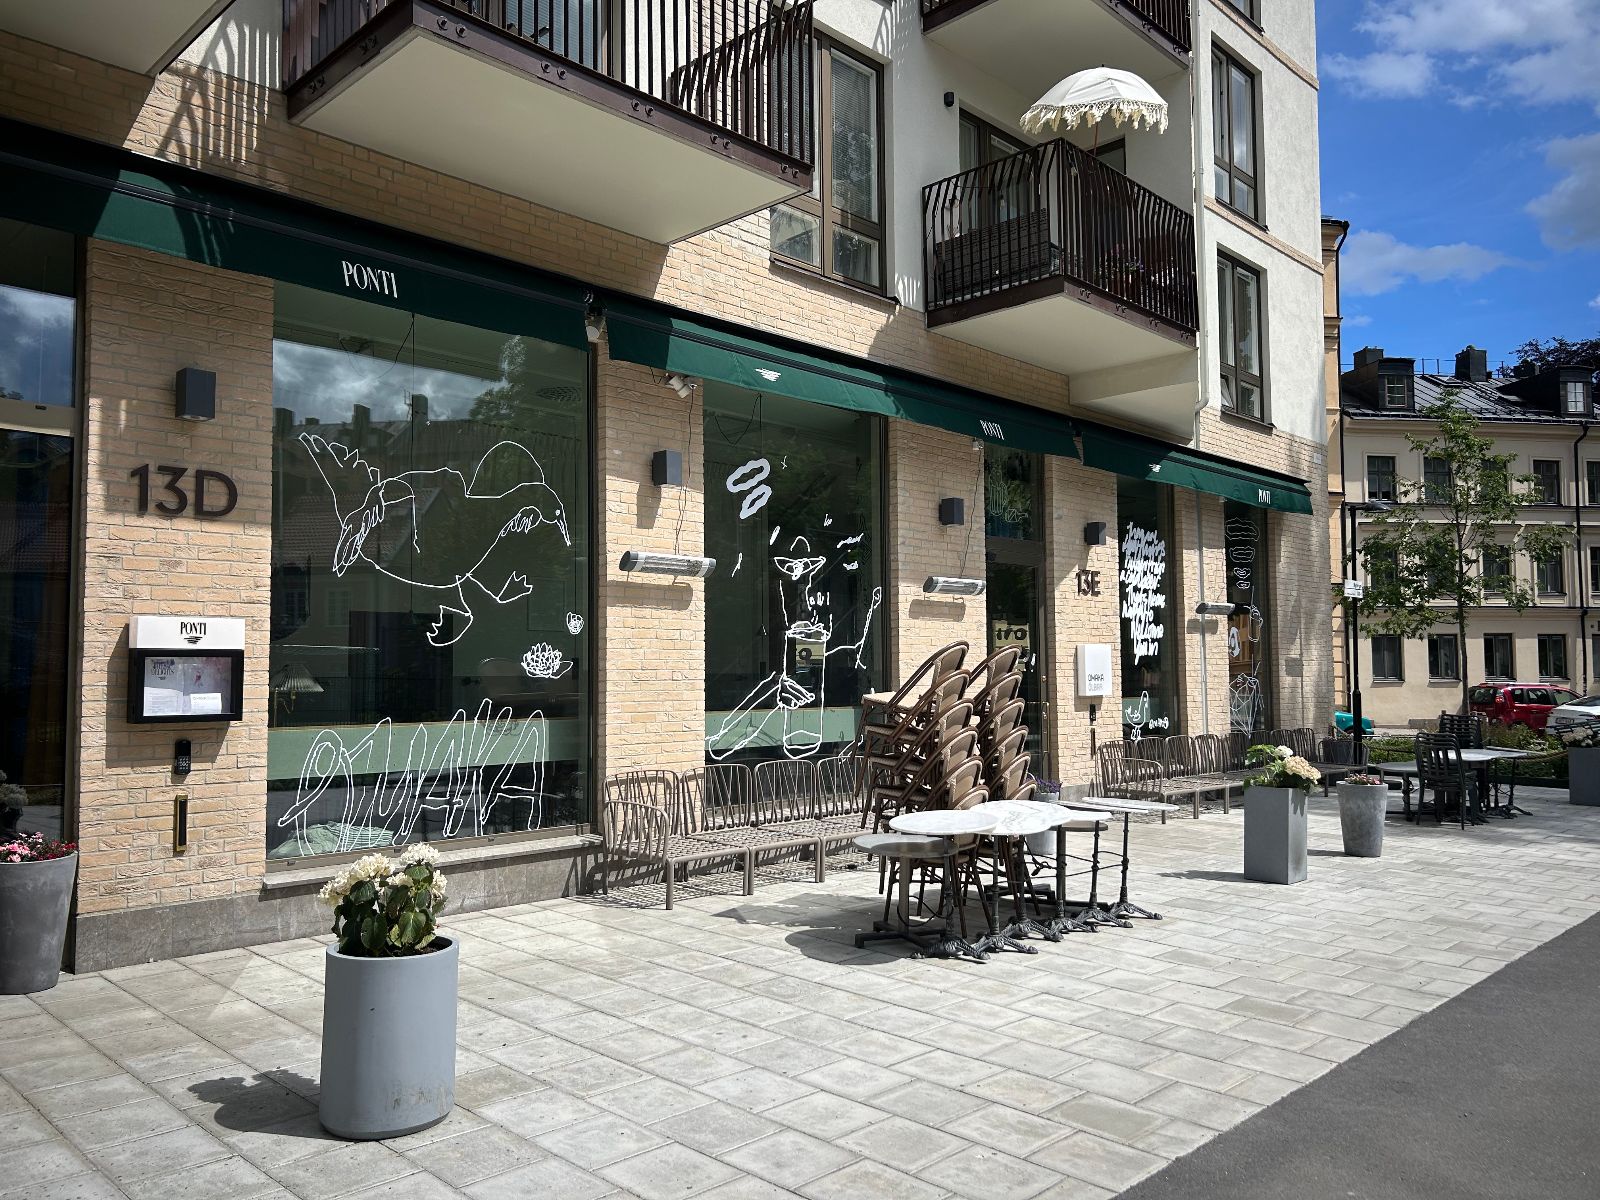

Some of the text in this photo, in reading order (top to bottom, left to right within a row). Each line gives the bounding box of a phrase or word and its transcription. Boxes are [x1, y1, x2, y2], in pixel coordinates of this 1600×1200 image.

[341, 260, 398, 299] PONTI
[979, 419, 1005, 441] PONTI
[130, 463, 239, 517] 13D
[1075, 569, 1101, 597] 13E
[180, 621, 207, 635] PONTI
